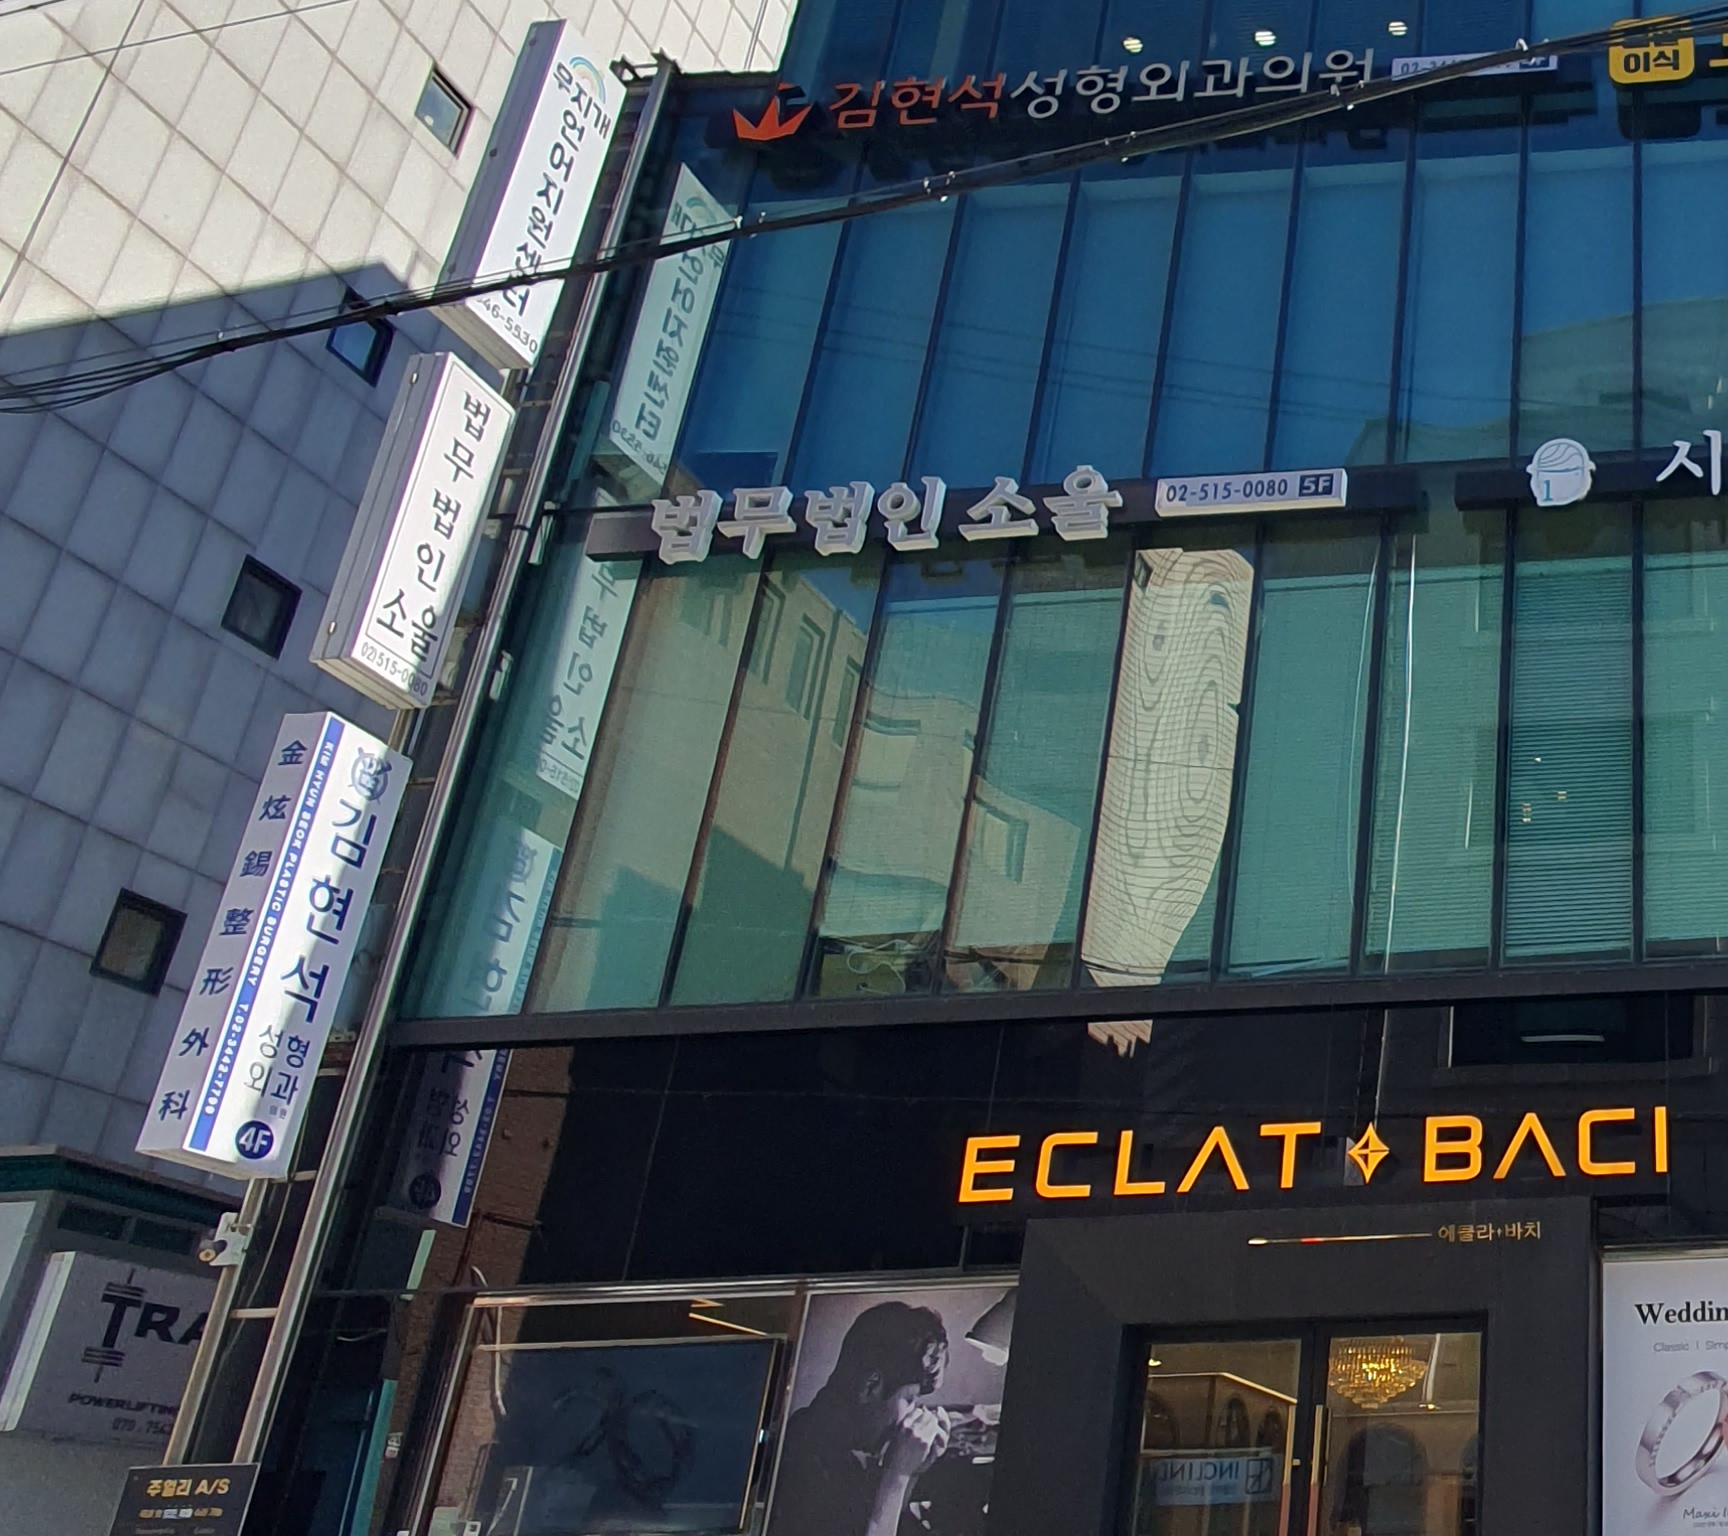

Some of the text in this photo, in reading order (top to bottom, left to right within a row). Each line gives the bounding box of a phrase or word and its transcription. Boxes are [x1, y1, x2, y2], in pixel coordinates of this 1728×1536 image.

[1623, 49, 1680, 74] 이식
[552, 61, 612, 140] 무지개
[476, 297, 538, 354] 46-5530
[416, 390, 491, 593] 법무법인
[651, 464, 1123, 565] 법무법인 소울
[1164, 475, 1333, 506] 02-515-0080 5F
[376, 589, 438, 663] 소울
[319, 740, 335, 767] KIM
[305, 771, 326, 809] HYUN
[291, 810, 312, 849] SEOK
[270, 851, 300, 913] PLASTIC
[280, 798, 378, 1024] 김현석
[248, 916, 278, 987] SURGERY
[238, 1125, 271, 1154] 4F
[957, 1105, 1669, 1203] ECLAT BACI
[146, 1478, 231, 1498] 주얼리 A/S
